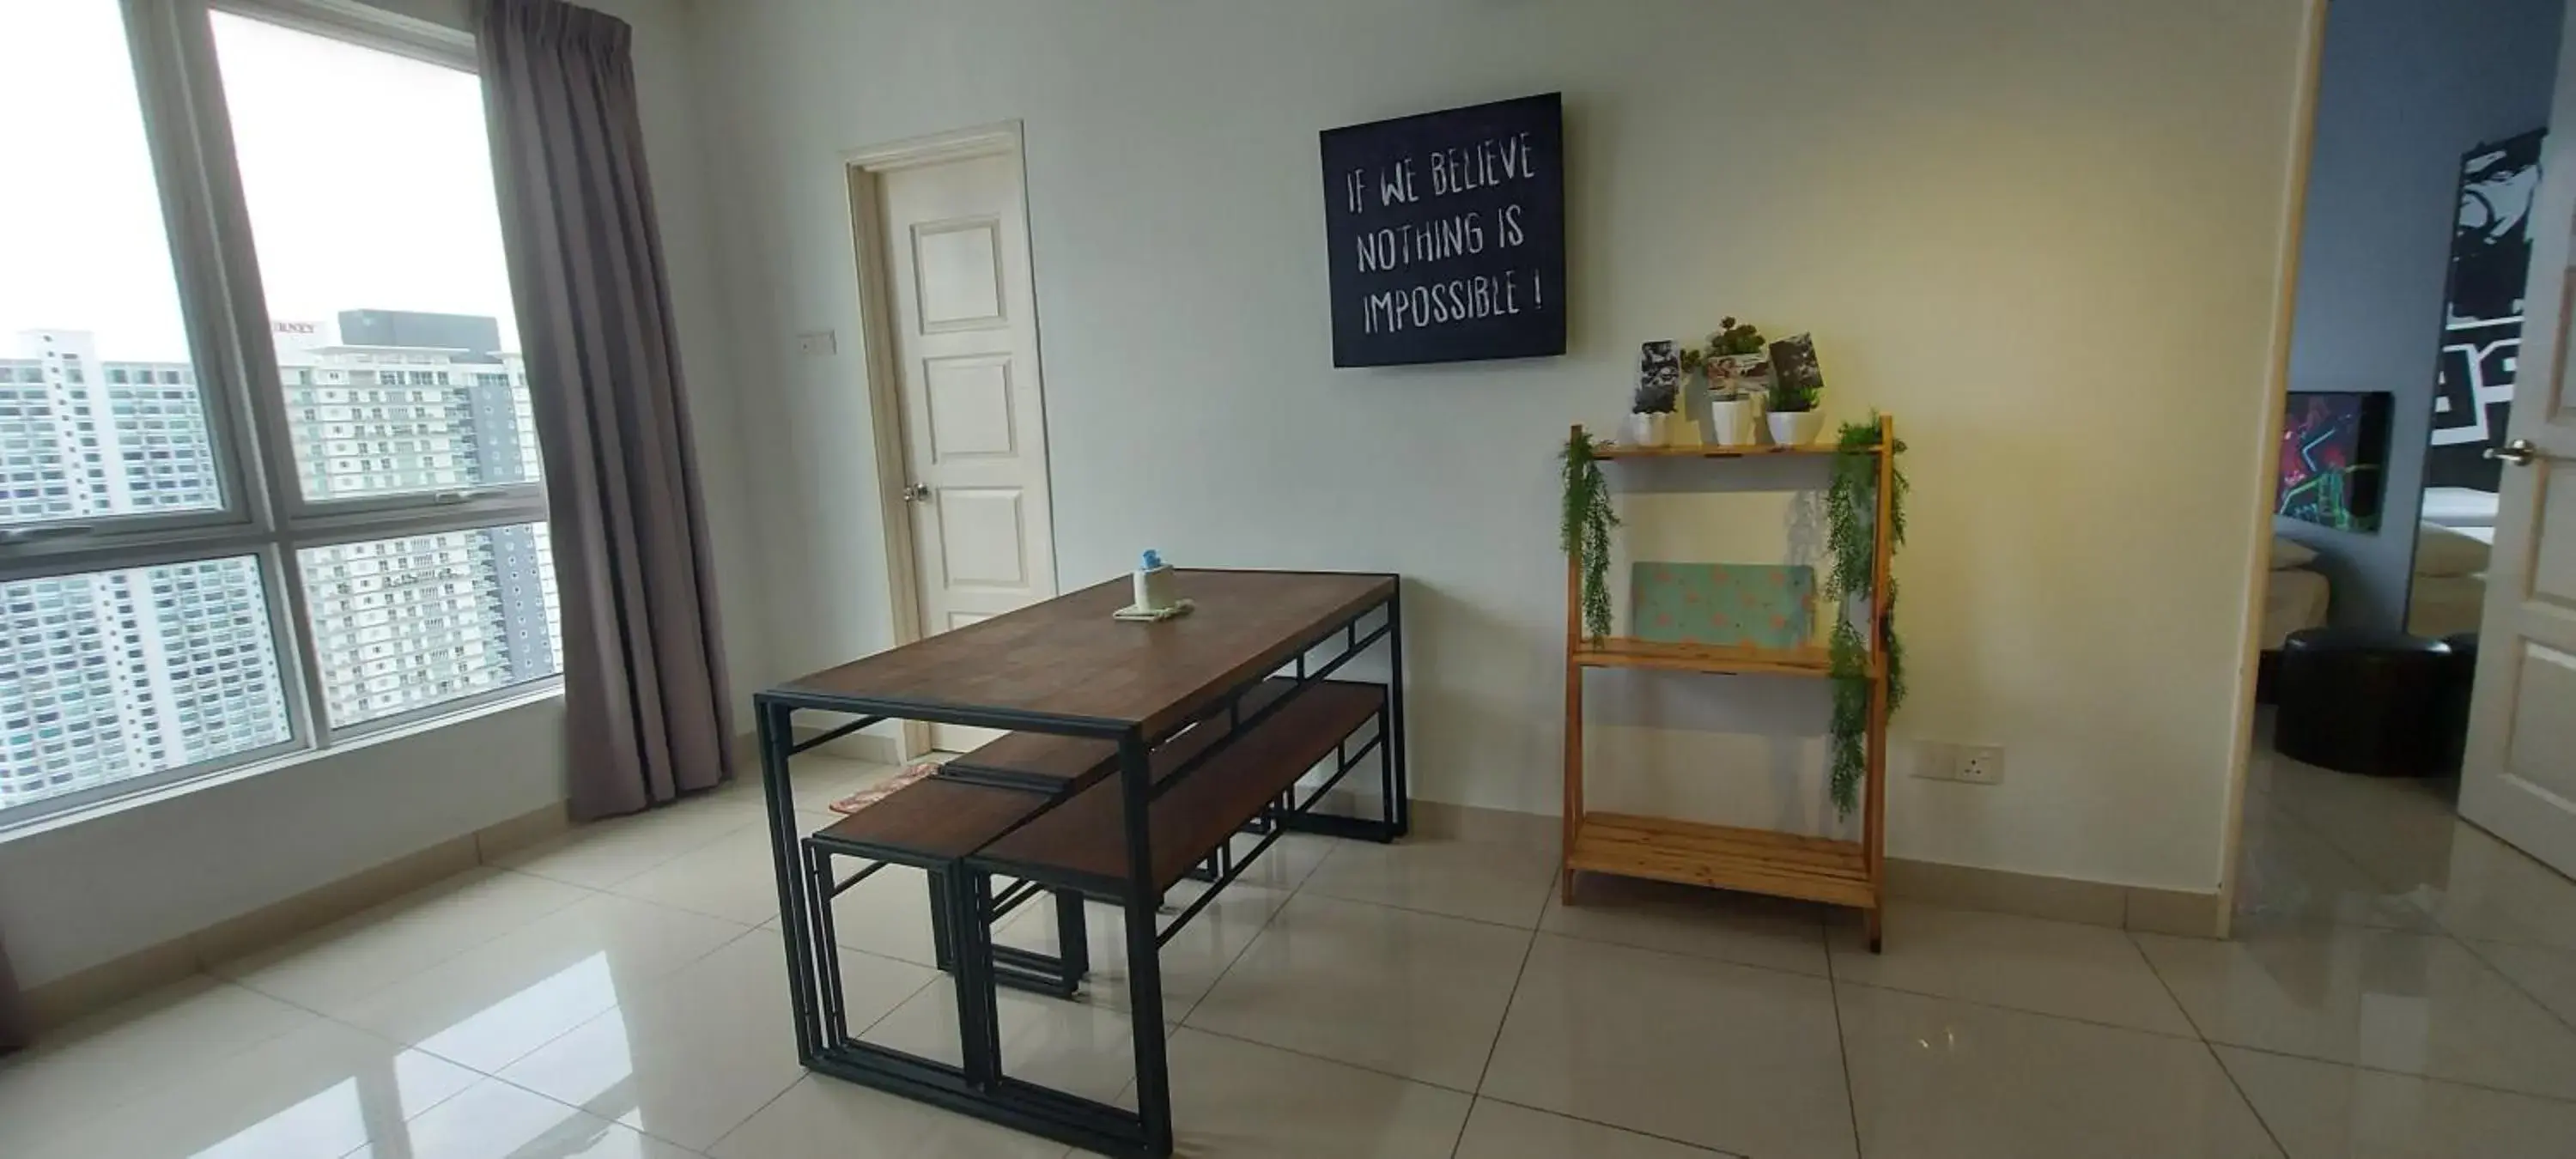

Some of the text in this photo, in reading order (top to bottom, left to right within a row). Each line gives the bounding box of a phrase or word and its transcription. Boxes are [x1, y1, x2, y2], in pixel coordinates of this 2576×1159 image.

[1346, 131, 1534, 214] IF WE BELIEVE
[1357, 203, 1524, 272] NOTHING IS
[1364, 270, 1520, 334] IMPOSSIBLE
